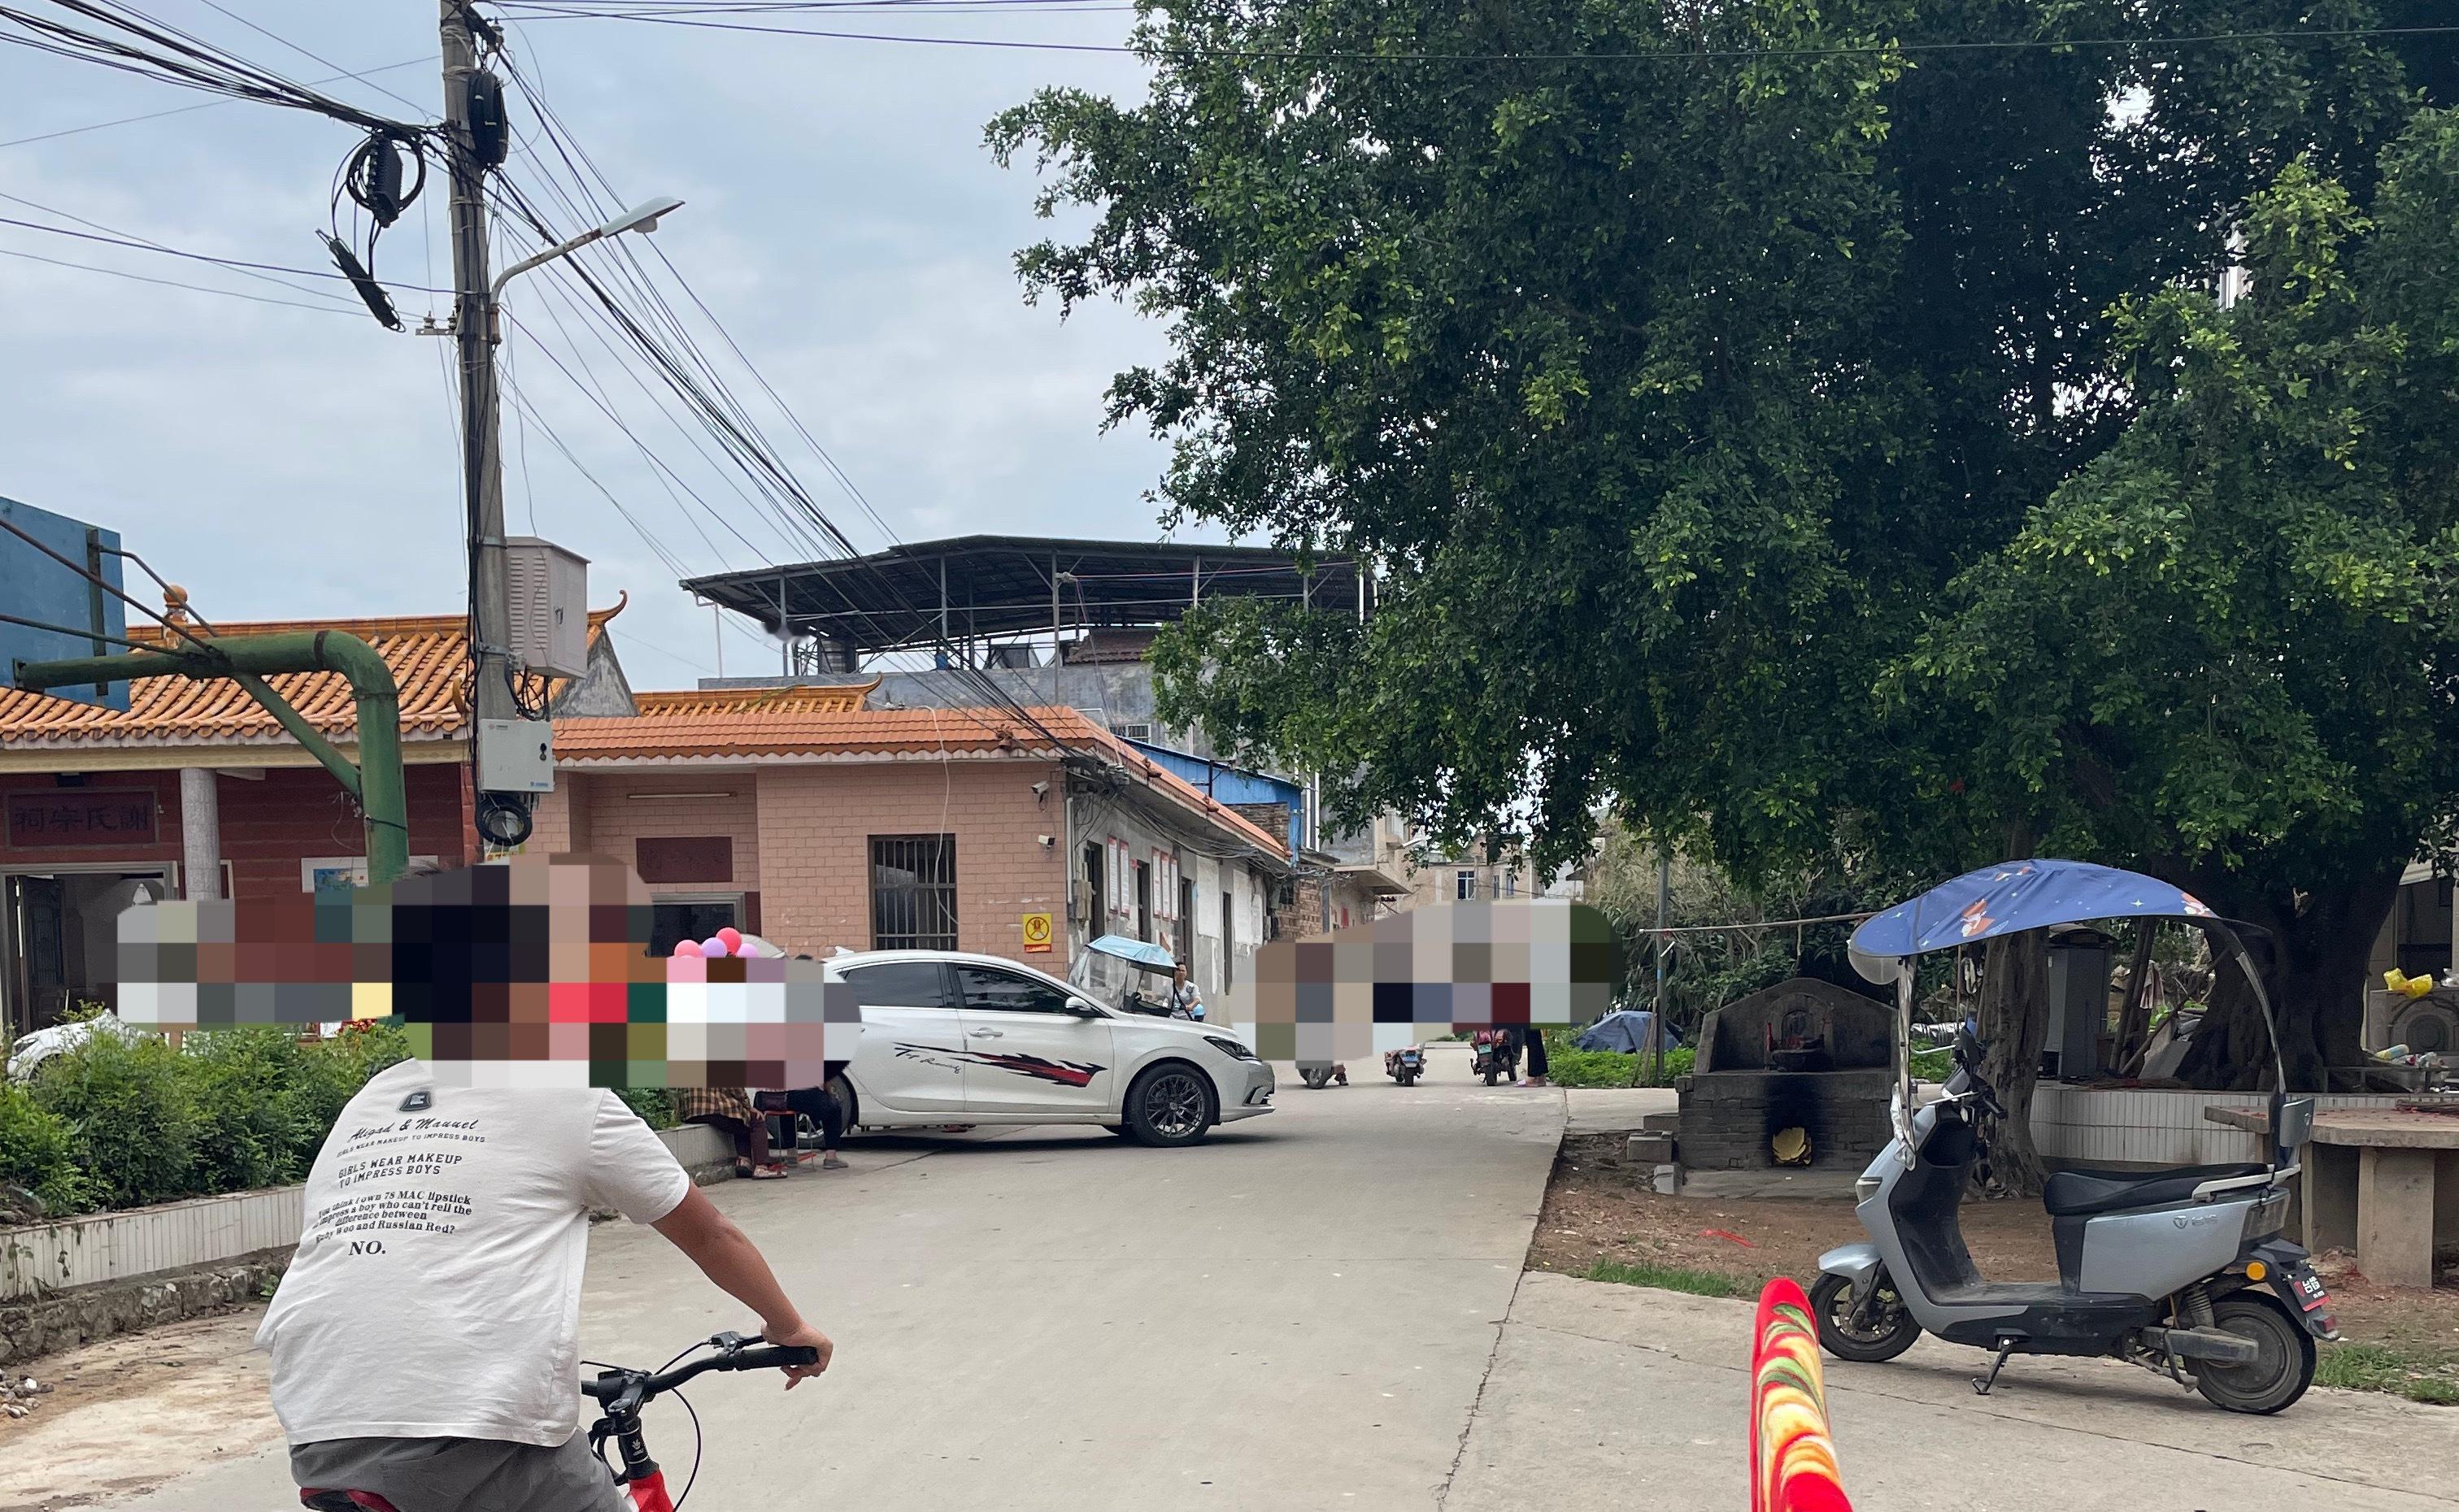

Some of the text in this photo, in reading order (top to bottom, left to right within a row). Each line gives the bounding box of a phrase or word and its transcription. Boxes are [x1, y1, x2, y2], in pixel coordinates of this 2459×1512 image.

[399, 1119, 412, 1131] &
[462, 1134, 486, 1143] BOYS
[338, 1153, 463, 1179] GIRLS WEAR MAKEUP
[339, 1164, 442, 1189] TO IMPRESS BOYS
[397, 1190, 425, 1200] MAC
[427, 1191, 472, 1206] lipstick
[358, 1202, 376, 1212] boy
[378, 1201, 400, 1210] who
[402, 1201, 429, 1210] can't
[453, 1205, 472, 1215] the
[381, 1210, 428, 1220] between
[356, 1221, 375, 1231] and
[377, 1219, 423, 1231] Russian
[425, 1222, 455, 1234] Red?
[347, 1240, 386, 1256] NO.
